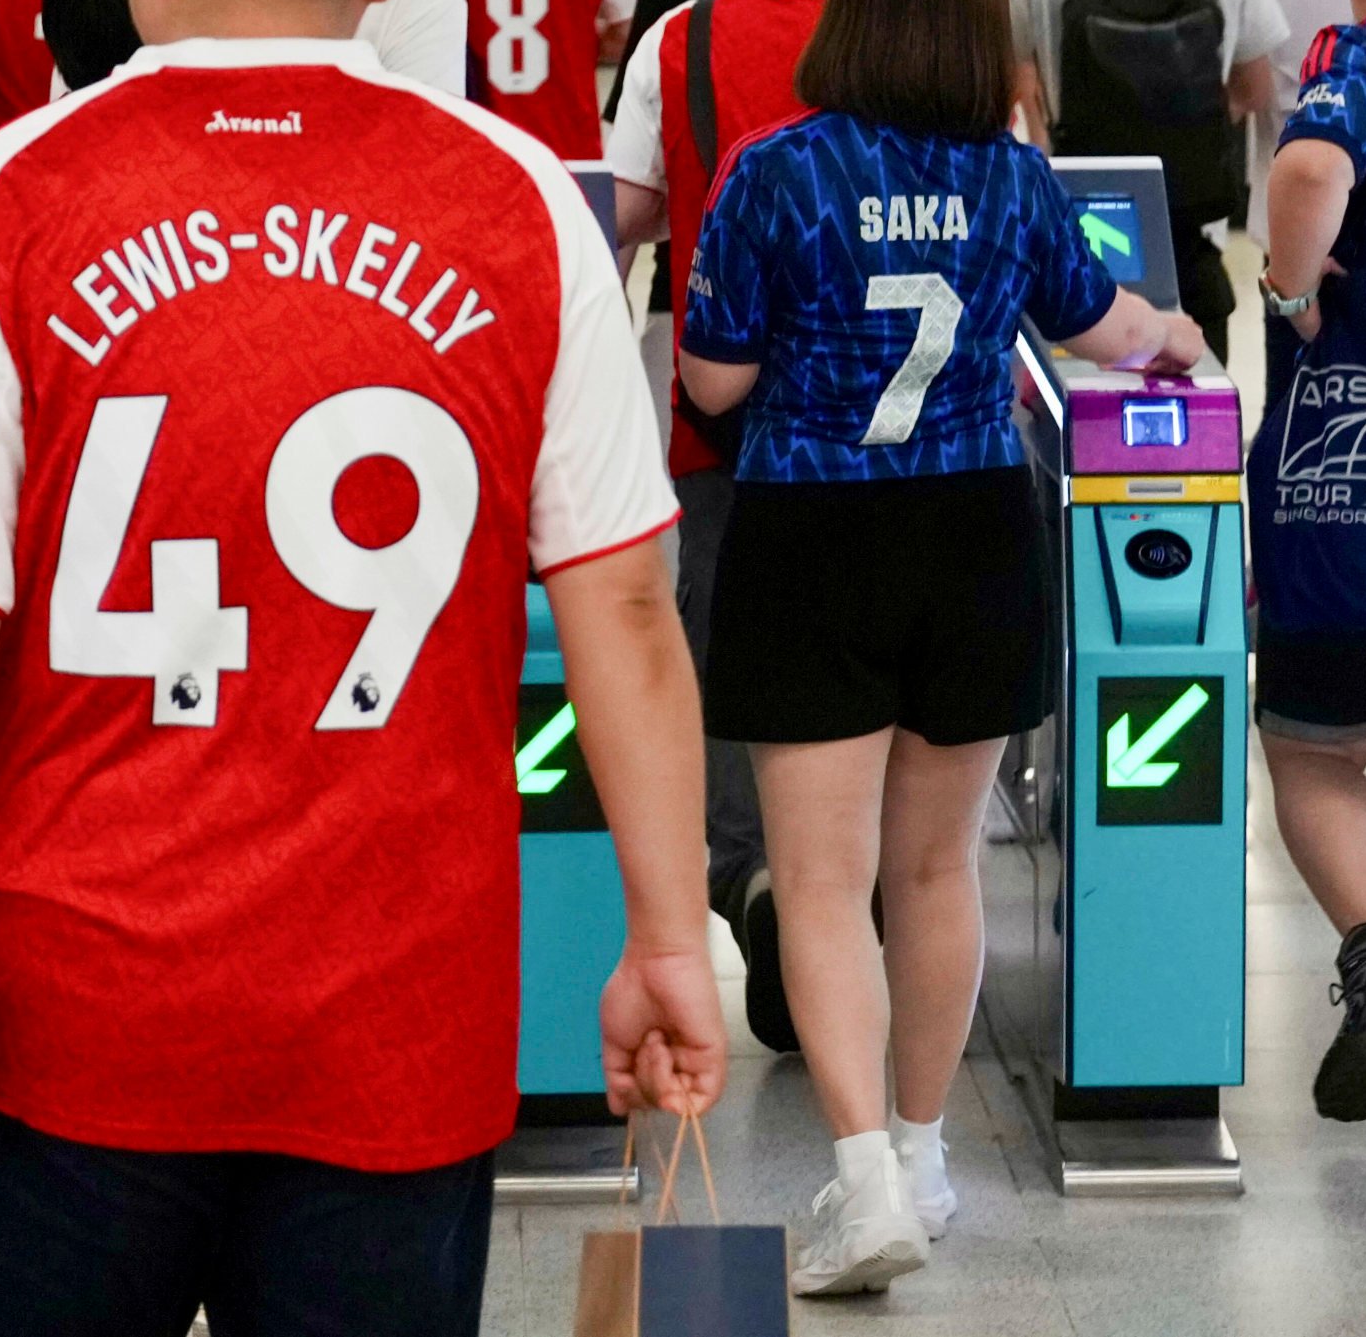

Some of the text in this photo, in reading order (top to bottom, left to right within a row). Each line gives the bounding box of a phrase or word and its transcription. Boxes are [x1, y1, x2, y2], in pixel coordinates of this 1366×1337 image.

[204, 109, 303, 136] Arsenal
[858, 193, 969, 242] SAKA
[45, 202, 497, 368] LEWIS-SKELLY
[858, 271, 966, 446] 7
[1276, 483, 1352, 507] TOUR
[47, 384, 482, 732] 49
